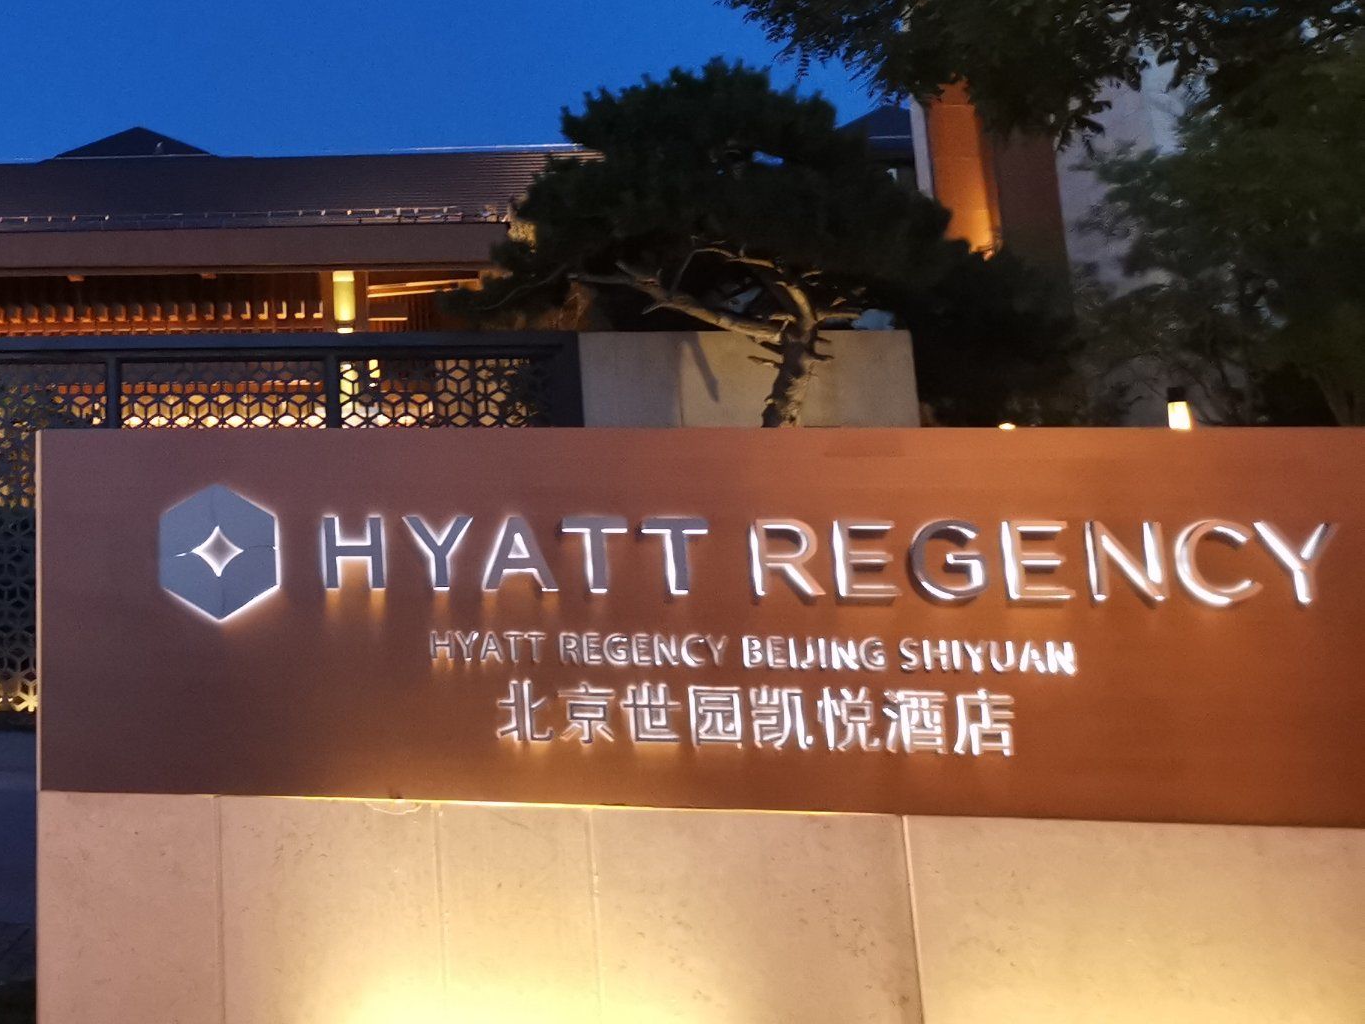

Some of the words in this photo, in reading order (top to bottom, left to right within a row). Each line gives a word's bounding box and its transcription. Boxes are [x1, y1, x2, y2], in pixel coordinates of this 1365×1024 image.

[321, 513, 710, 595] HYATT
[747, 518, 1335, 606] REGENCY
[429, 631, 546, 664] HYATT
[559, 632, 730, 668] REGENCY
[741, 635, 887, 671] BEIJING
[898, 637, 1078, 676] SHIYUAN
[496, 679, 1016, 757] 北京世园凯悦酒店
